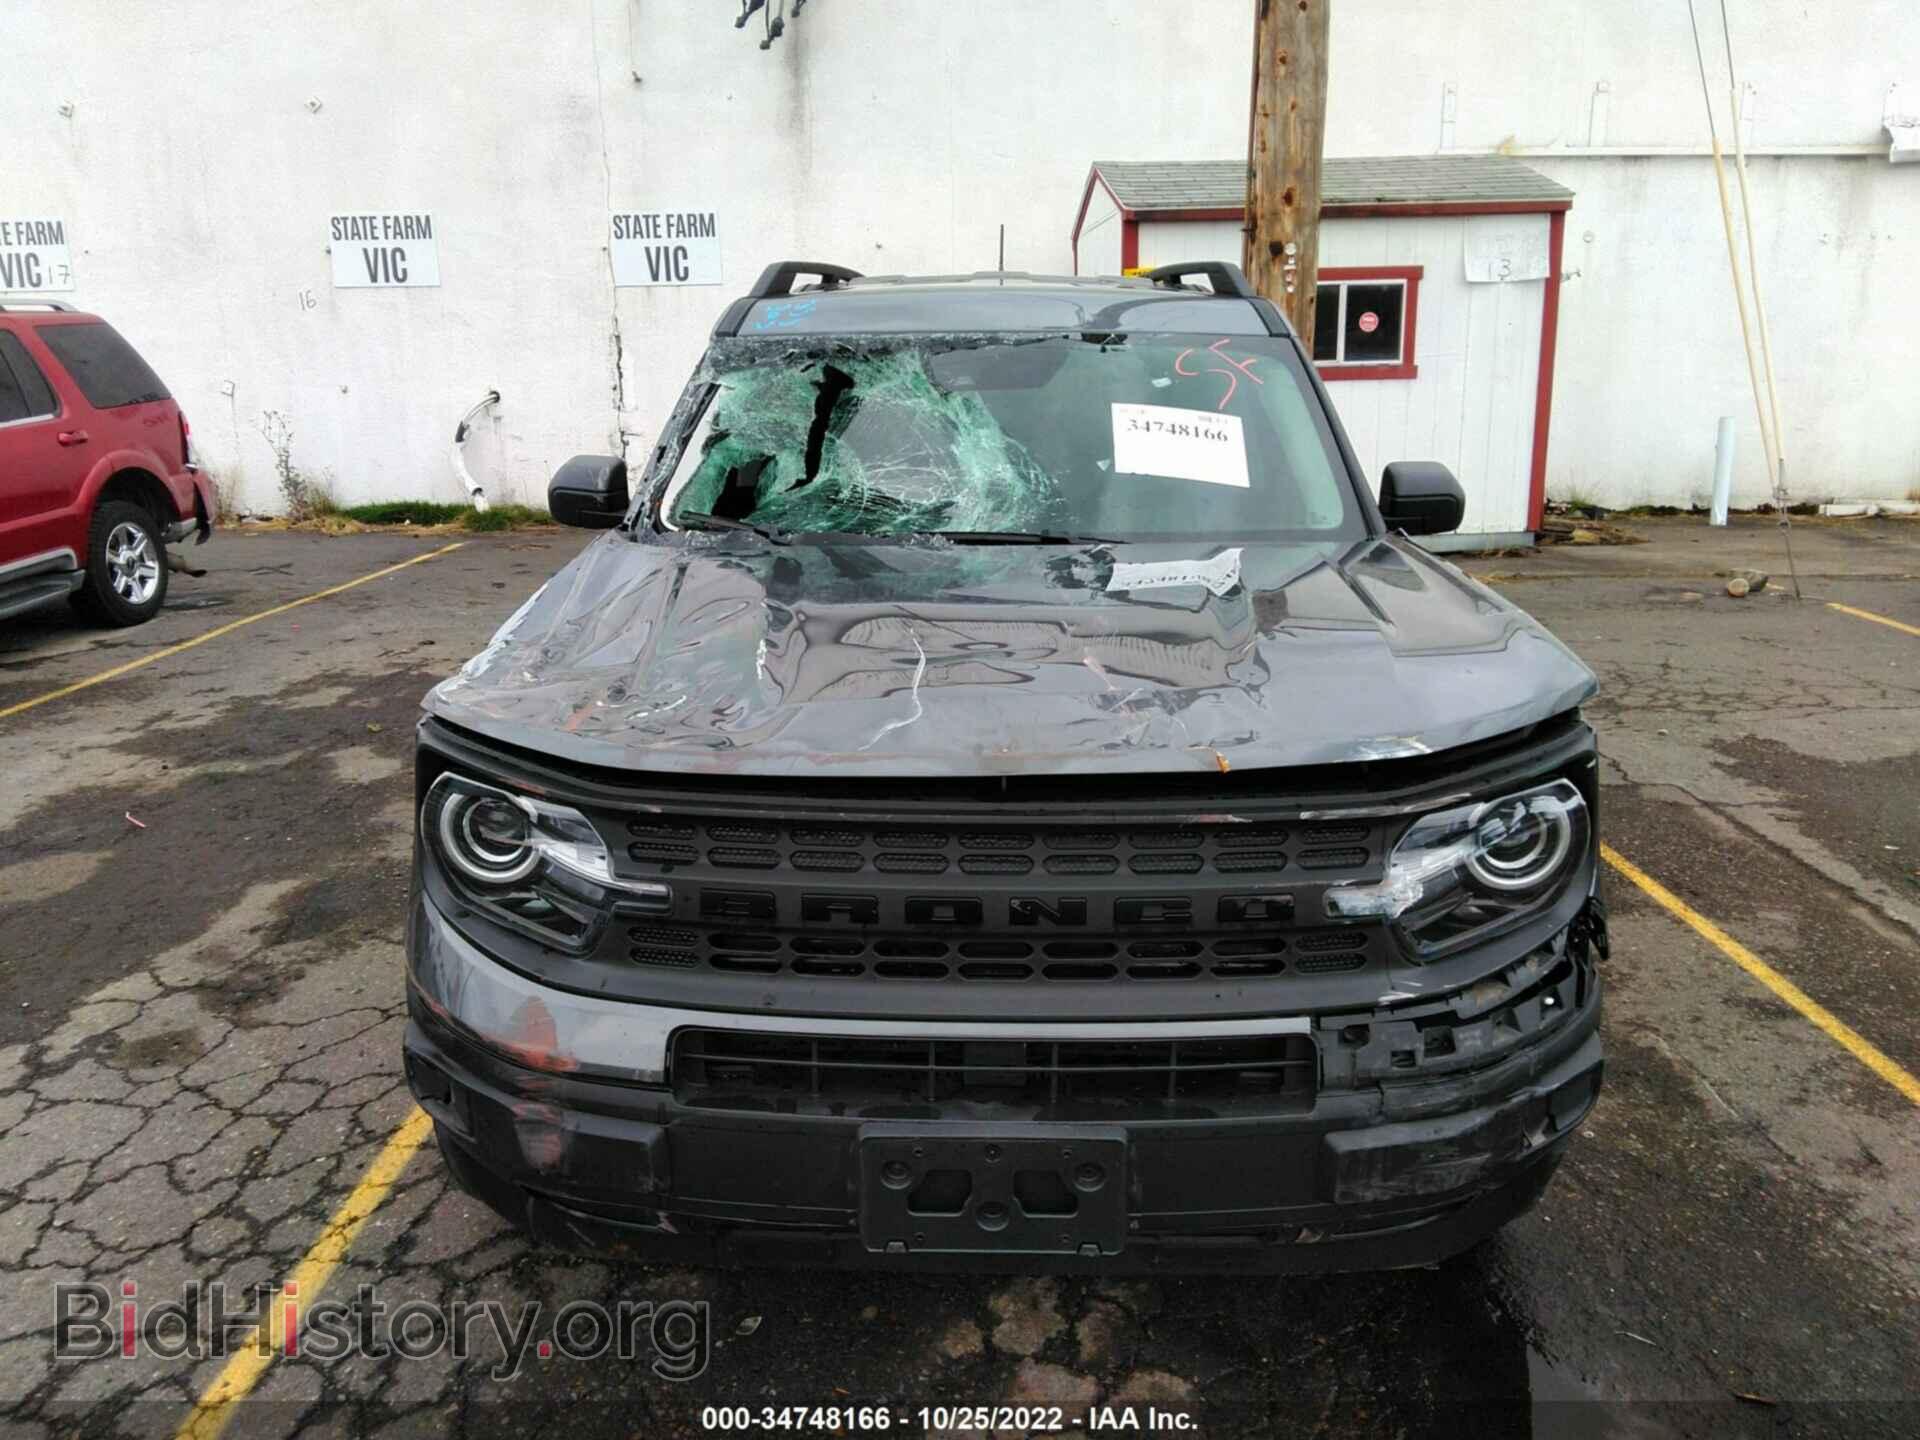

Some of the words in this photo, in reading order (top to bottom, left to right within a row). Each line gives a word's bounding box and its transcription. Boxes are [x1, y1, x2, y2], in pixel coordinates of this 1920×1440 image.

[14, 220, 65, 246] FARM
[330, 215, 380, 241] STATE
[382, 214, 433, 241] FARM
[612, 214, 662, 240] STATE
[665, 212, 716, 239] FARM
[362, 246, 408, 284] VIC
[644, 245, 690, 283] VIC
[298, 289, 318, 311] 16
[1127, 418, 1229, 443] 34748166
[700, 888, 1295, 925] BRONCO
